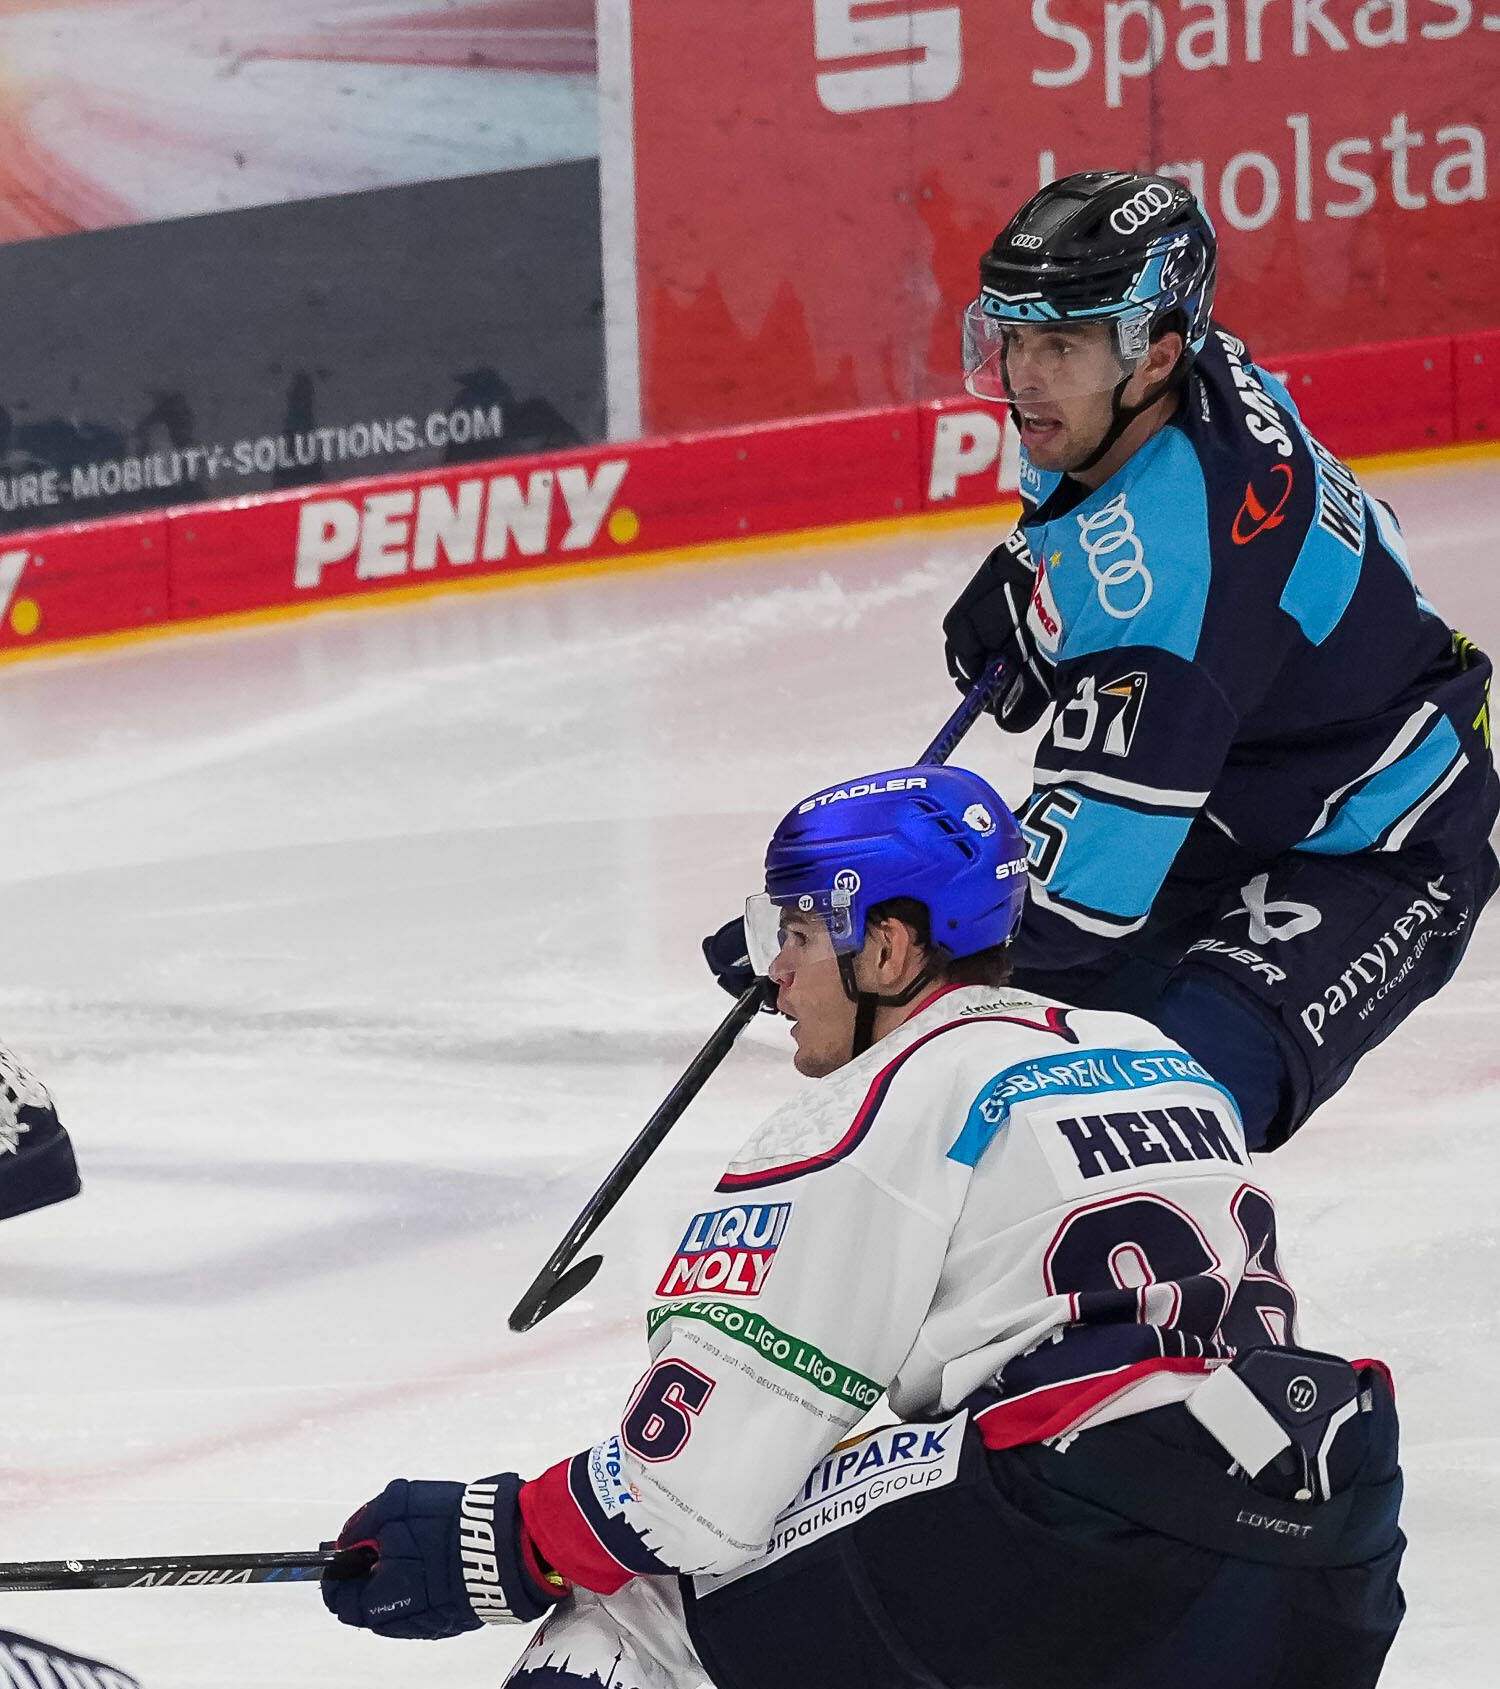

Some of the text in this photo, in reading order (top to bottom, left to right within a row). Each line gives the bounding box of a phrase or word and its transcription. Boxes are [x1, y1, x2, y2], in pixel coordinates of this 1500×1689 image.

[1036, 112, 1488, 234] Iolsta
[798, 777, 928, 815] STADLER
[1178, 938, 1288, 986] AUER
[1055, 1106, 1244, 1180] HEIM
[682, 1202, 791, 1255] LIQUI
[662, 1252, 776, 1296] MOLY
[745, 1318, 792, 1361] LIGO
[794, 1348, 838, 1387] LIGO
[842, 1374, 879, 1407] LIGO
[620, 1356, 717, 1464] 6
[800, 1423, 953, 1502] TIPARK
[1236, 1510, 1314, 1538] COVERT
[128, 1568, 254, 1588] ALPHA
